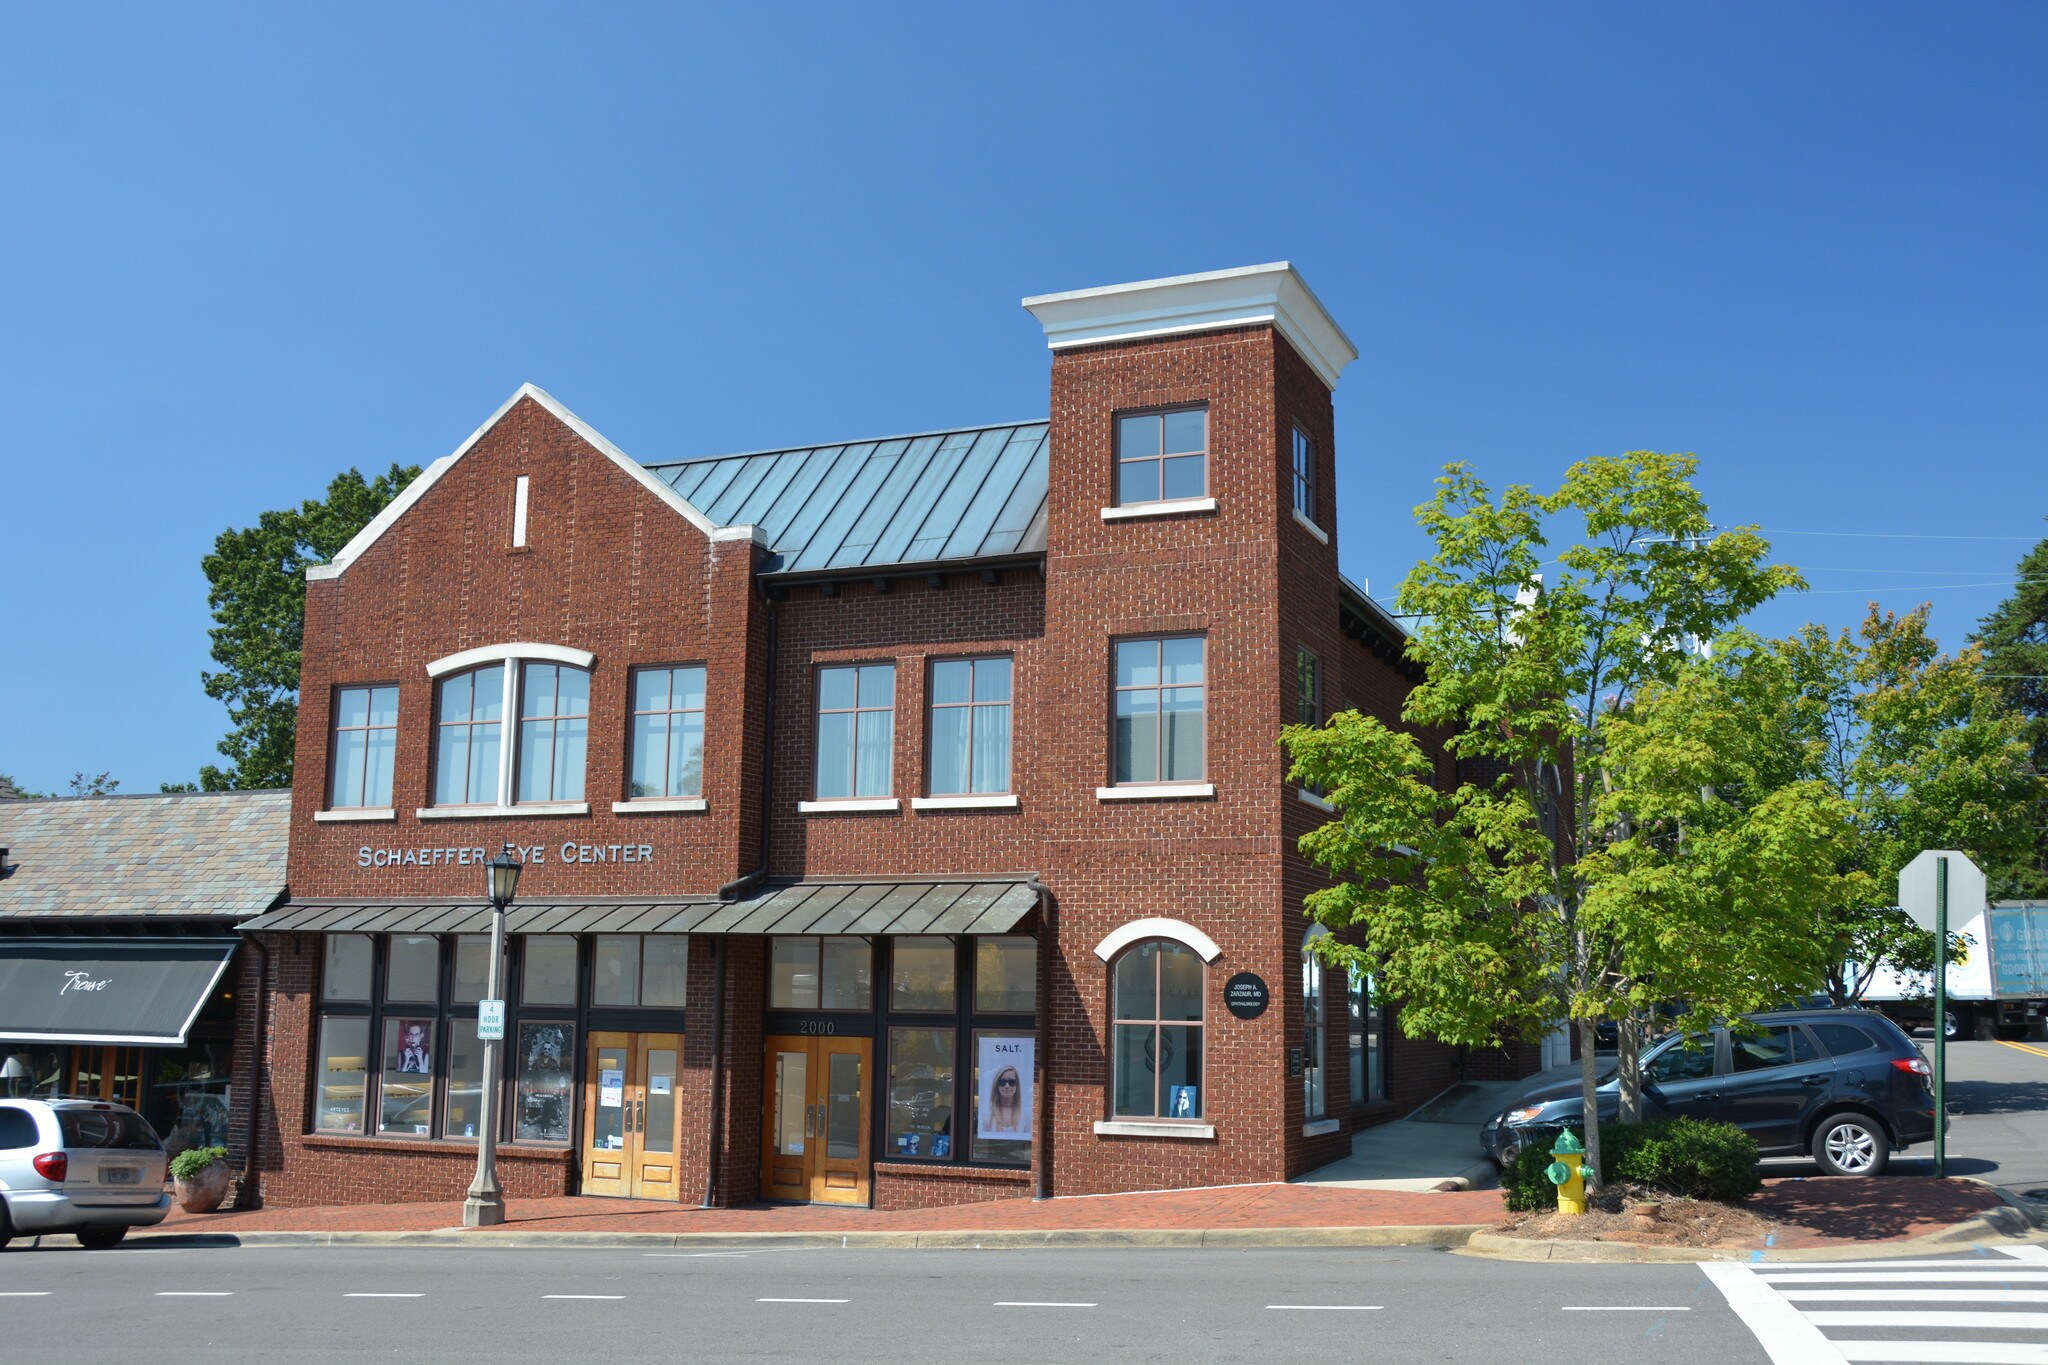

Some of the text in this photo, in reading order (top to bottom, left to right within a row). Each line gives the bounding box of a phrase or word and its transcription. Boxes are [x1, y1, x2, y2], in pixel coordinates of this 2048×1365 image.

[357, 845, 487, 867] SCHAEFFER
[560, 841, 653, 864] CENTER
[483, 1015, 500, 1023] HOUR
[480, 1025, 502, 1033] PARKING
[800, 1020, 834, 1035] 2000
[995, 1044, 1022, 1053] SALT.
